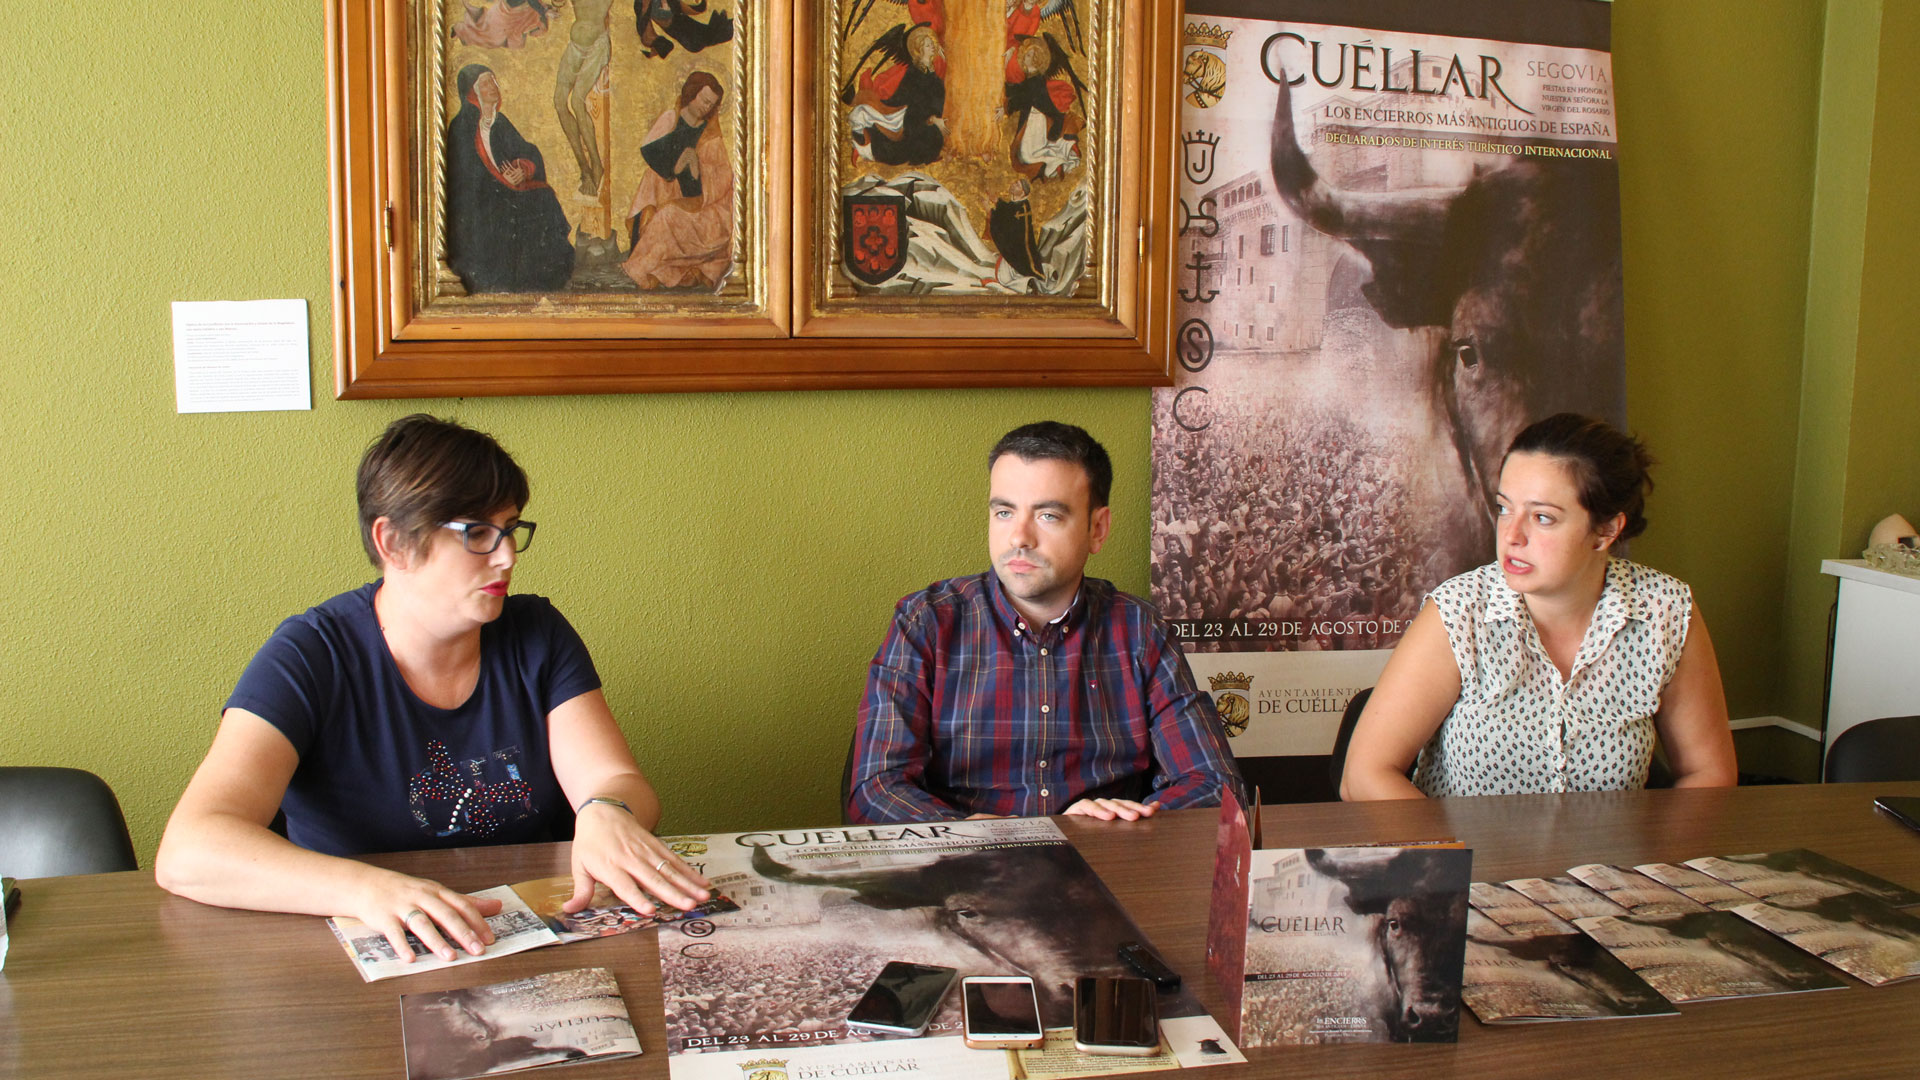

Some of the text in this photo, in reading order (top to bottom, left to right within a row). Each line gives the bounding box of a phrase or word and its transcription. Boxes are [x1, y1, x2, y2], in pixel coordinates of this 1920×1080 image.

[1260, 32, 1535, 115] CUÉLLAR
[1527, 60, 1607, 82] SEGOVIA
[1542, 84, 1566, 93] FIESTAS
[1566, 86, 1577, 94] EN
[1541, 94, 1572, 103] NUESTRA
[1572, 95, 1601, 105] SEÑORA
[1541, 104, 1611, 116] VIRGEN DEL ROSARIO
[1325, 105, 1611, 137] LOS ENCIERROS MÁS ANTIGUOS DE ESPAÑA
[1325, 132, 1612, 160] DECLARADOS DE INTERÉS TURÍSTICO INTERNACIONAL
[1203, 622, 1224, 638] 23
[1230, 622, 1253, 637] AL
[1258, 622, 1278, 637] 29
[1282, 621, 1303, 636] DE
[1309, 620, 1379, 636] AGOSTO
[1382, 619, 1402, 634] DE
[1258, 687, 1362, 698] AYUNTAMIENTO
[1258, 696, 1351, 713] DE CUÉLLA
[824, 844, 895, 852] ENCIERROS
[984, 841, 1066, 850] INTERNACIONAL
[928, 1022, 952, 1031] DE
[687, 1037, 725, 1047] DEL
[728, 1035, 750, 1044] 23
[758, 1032, 785, 1043] AL
[788, 1031, 811, 1041] 29
[814, 1029, 839, 1040] DE
[798, 1057, 917, 1071] AYUNTAMIENTO
[798, 1070, 826, 1080] DE
